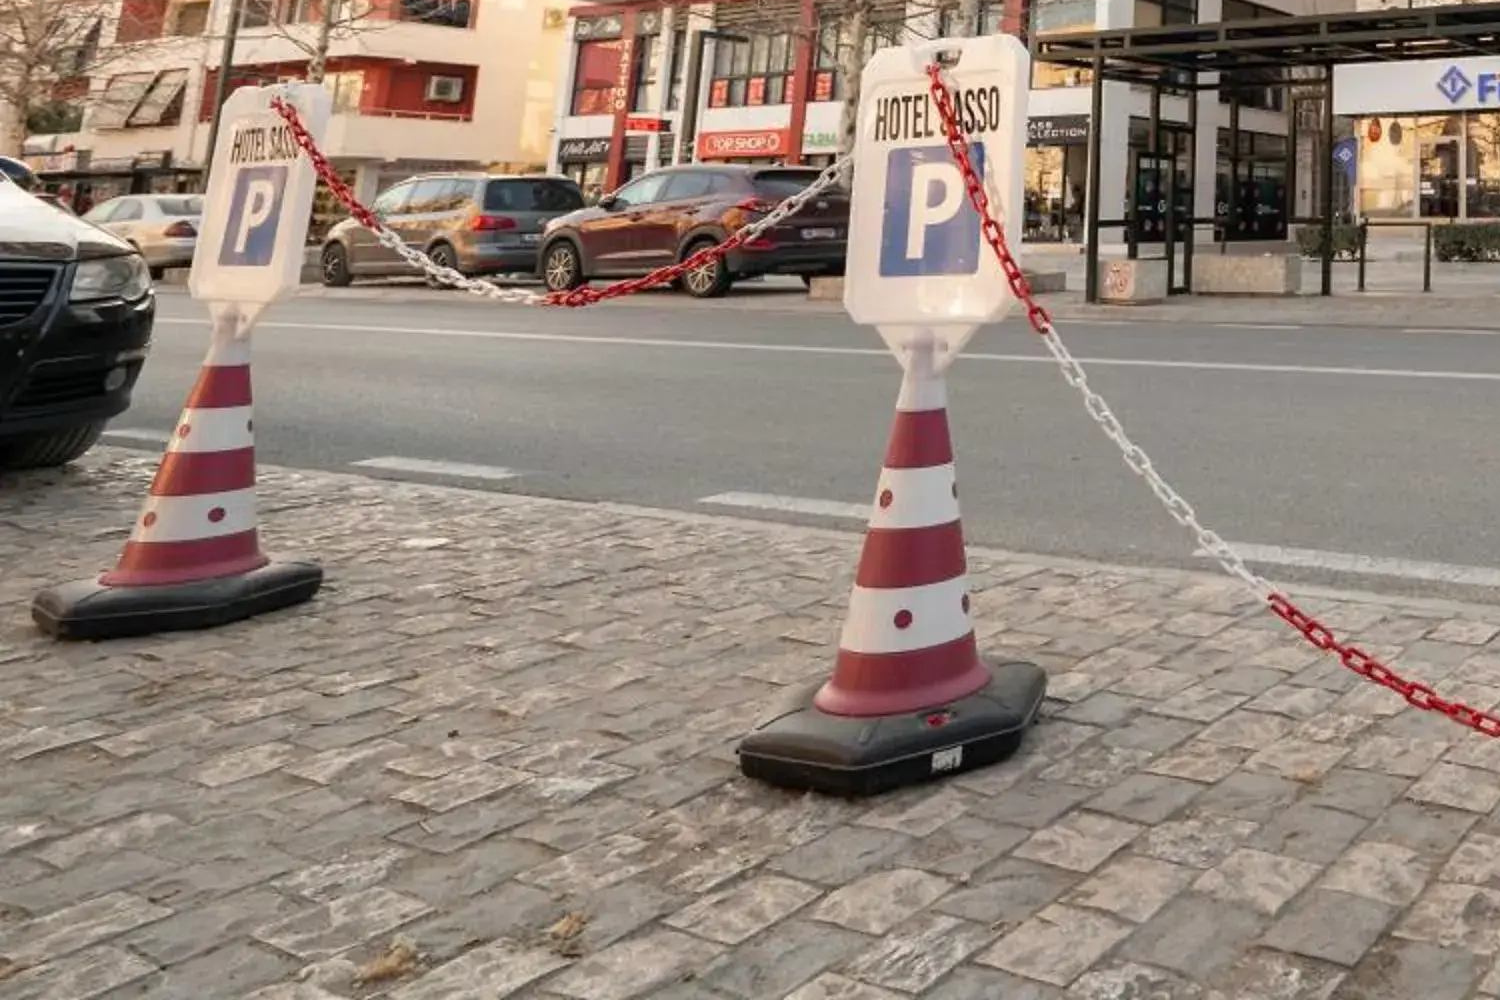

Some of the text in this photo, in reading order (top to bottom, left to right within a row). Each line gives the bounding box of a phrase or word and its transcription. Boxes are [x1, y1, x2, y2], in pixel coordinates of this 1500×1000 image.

[230, 128, 267, 163] HOTEL
[875, 86, 1000, 142] HOTEL ASSO
[234, 180, 274, 254] P
[906, 162, 965, 260] P
